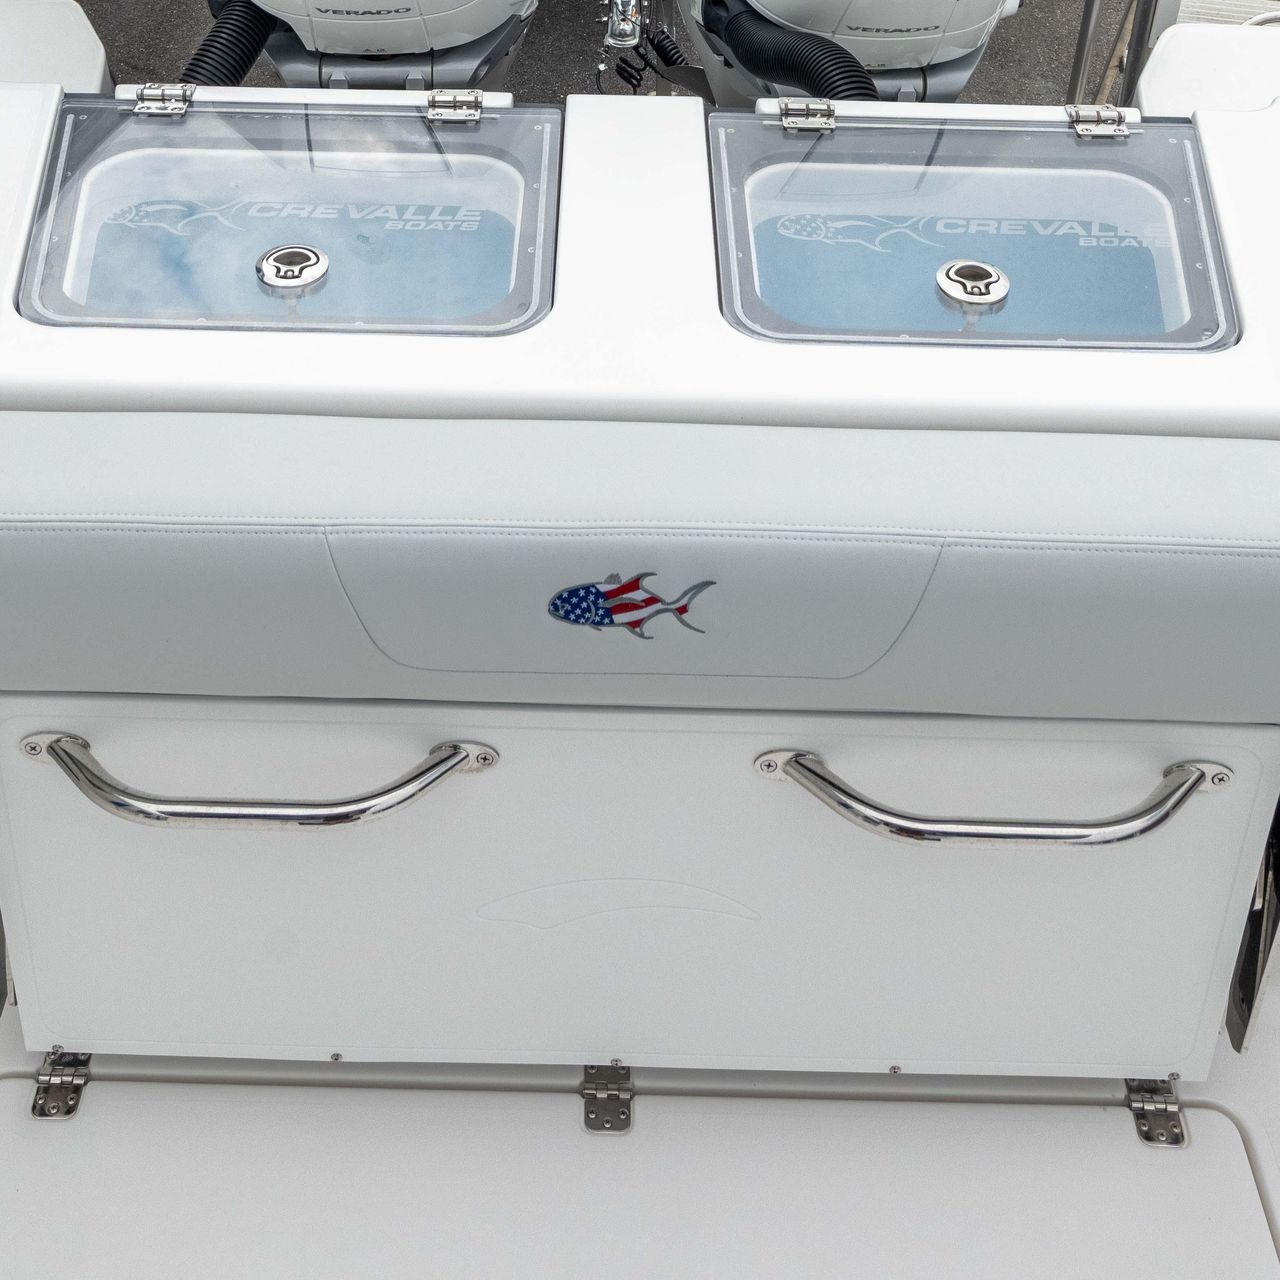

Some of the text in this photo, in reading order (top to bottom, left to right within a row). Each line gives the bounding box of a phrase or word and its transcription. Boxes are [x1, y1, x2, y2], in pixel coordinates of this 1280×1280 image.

[315, 7, 412, 16] VERADO
[846, 24, 941, 34] VERADO
[247, 202, 482, 221] CREVALLE
[383, 220, 480, 232] BOATS
[934, 218, 1170, 237] CREVALLE
[1078, 236, 1171, 249] BOATS
